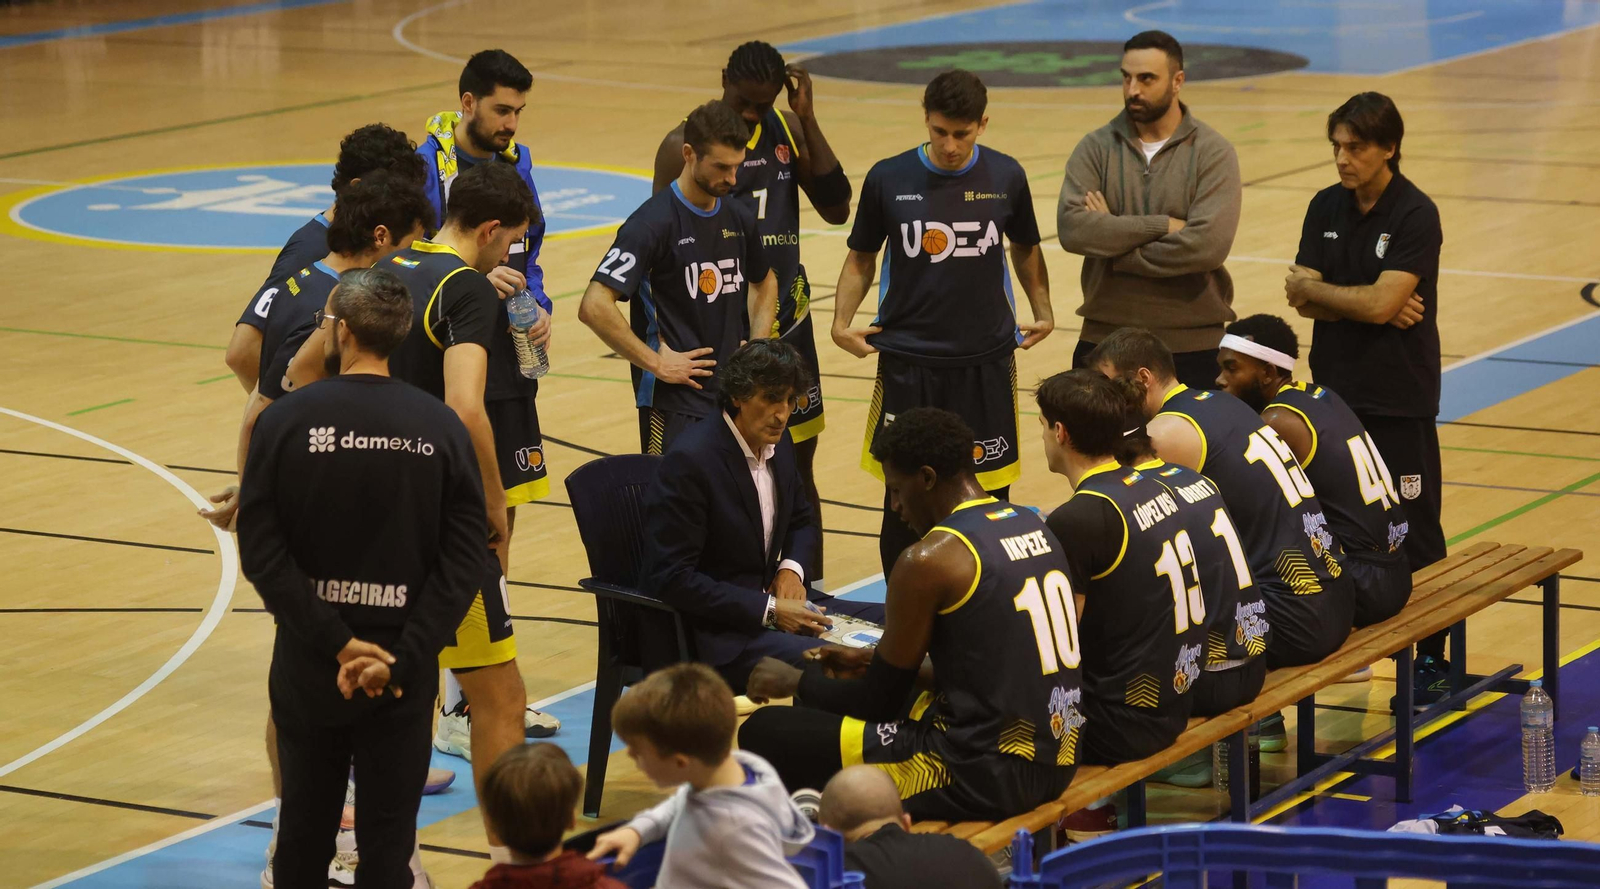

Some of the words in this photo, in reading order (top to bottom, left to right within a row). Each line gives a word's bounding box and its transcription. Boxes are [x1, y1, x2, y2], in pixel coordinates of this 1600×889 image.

[752, 188, 768, 220] 7
[759, 230, 798, 249] mex.io
[597, 247, 637, 284] 22
[254, 287, 279, 319] 6
[340, 430, 435, 457] damex.io
[1243, 424, 1316, 509] 15
[1132, 498, 1166, 532] LÓPEZ
[1000, 529, 1052, 562] IKPEZE
[1210, 507, 1253, 590] 1
[1154, 529, 1206, 634] 13
[1013, 569, 1081, 676] 10
